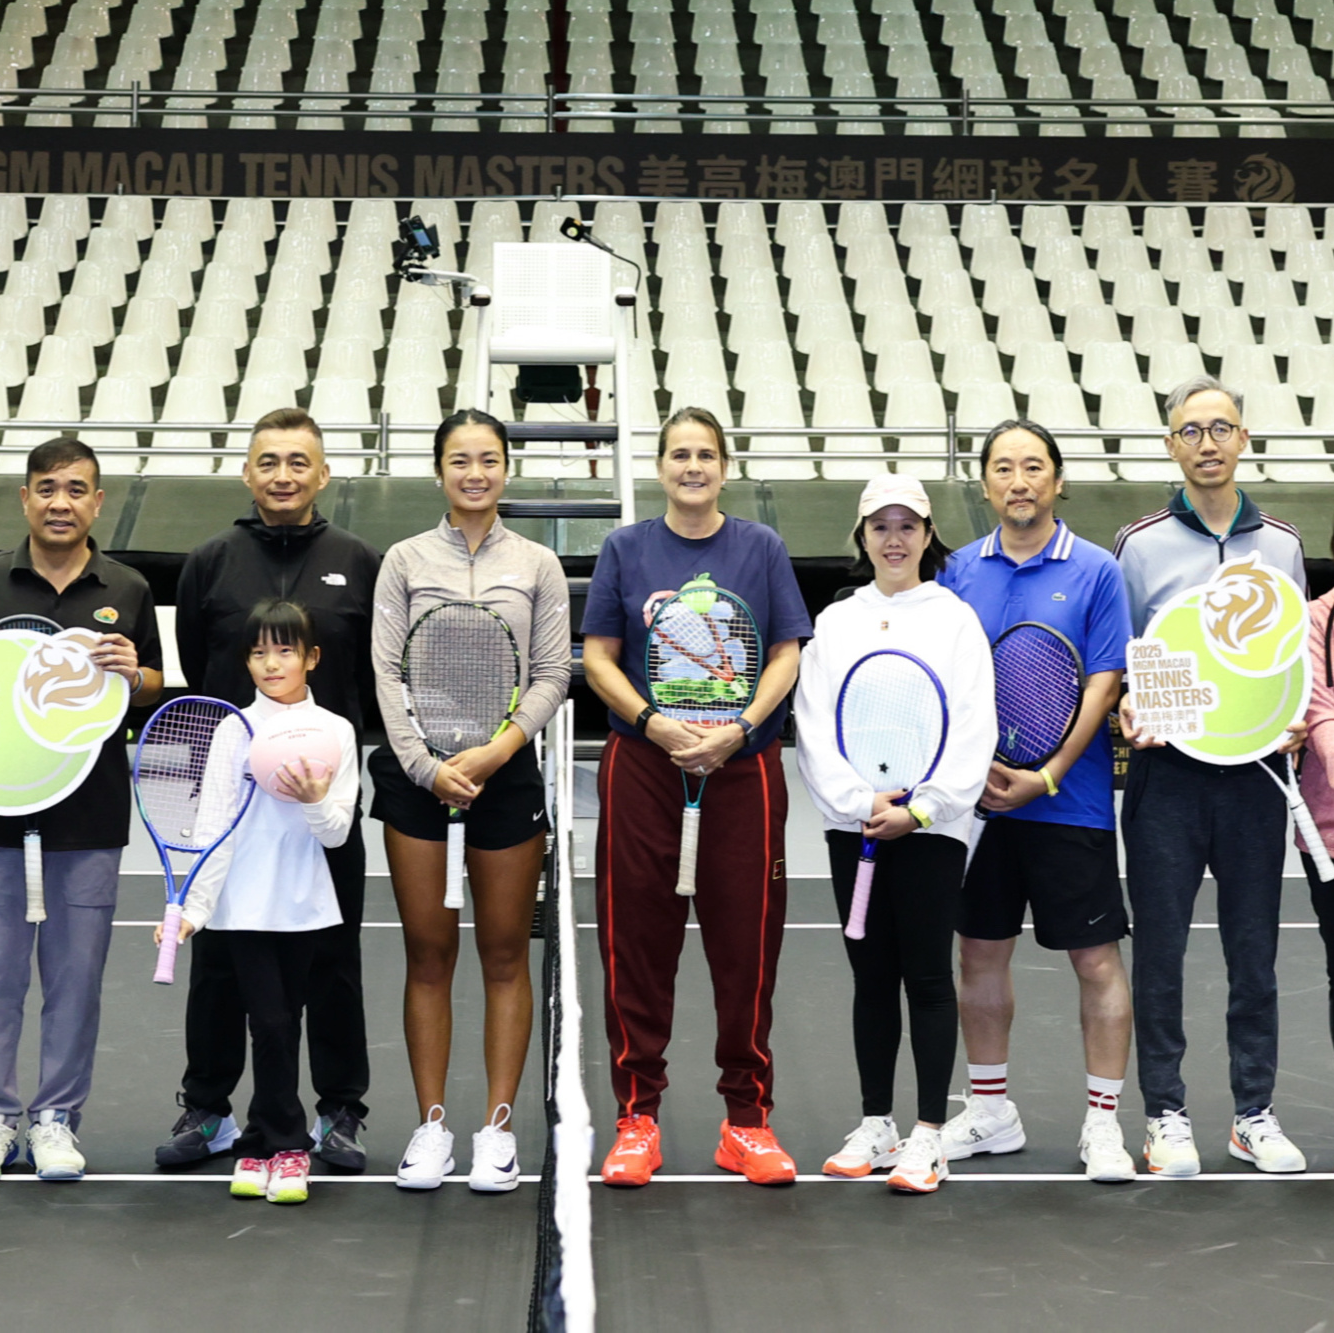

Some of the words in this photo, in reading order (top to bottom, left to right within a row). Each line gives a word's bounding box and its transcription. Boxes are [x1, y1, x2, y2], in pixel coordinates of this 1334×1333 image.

[64, 151, 223, 195] MACAU
[239, 153, 399, 197] TENNIS
[413, 154, 625, 198] MASTERS
[638, 154, 1220, 202] 美高梅澳門網球名人賽
[1133, 645, 1162, 659] 2025
[1133, 660, 1156, 671] MGM
[1158, 657, 1191, 669] MACAU
[1134, 669, 1192, 690] TENNIS
[1137, 688, 1213, 709] MASTERS
